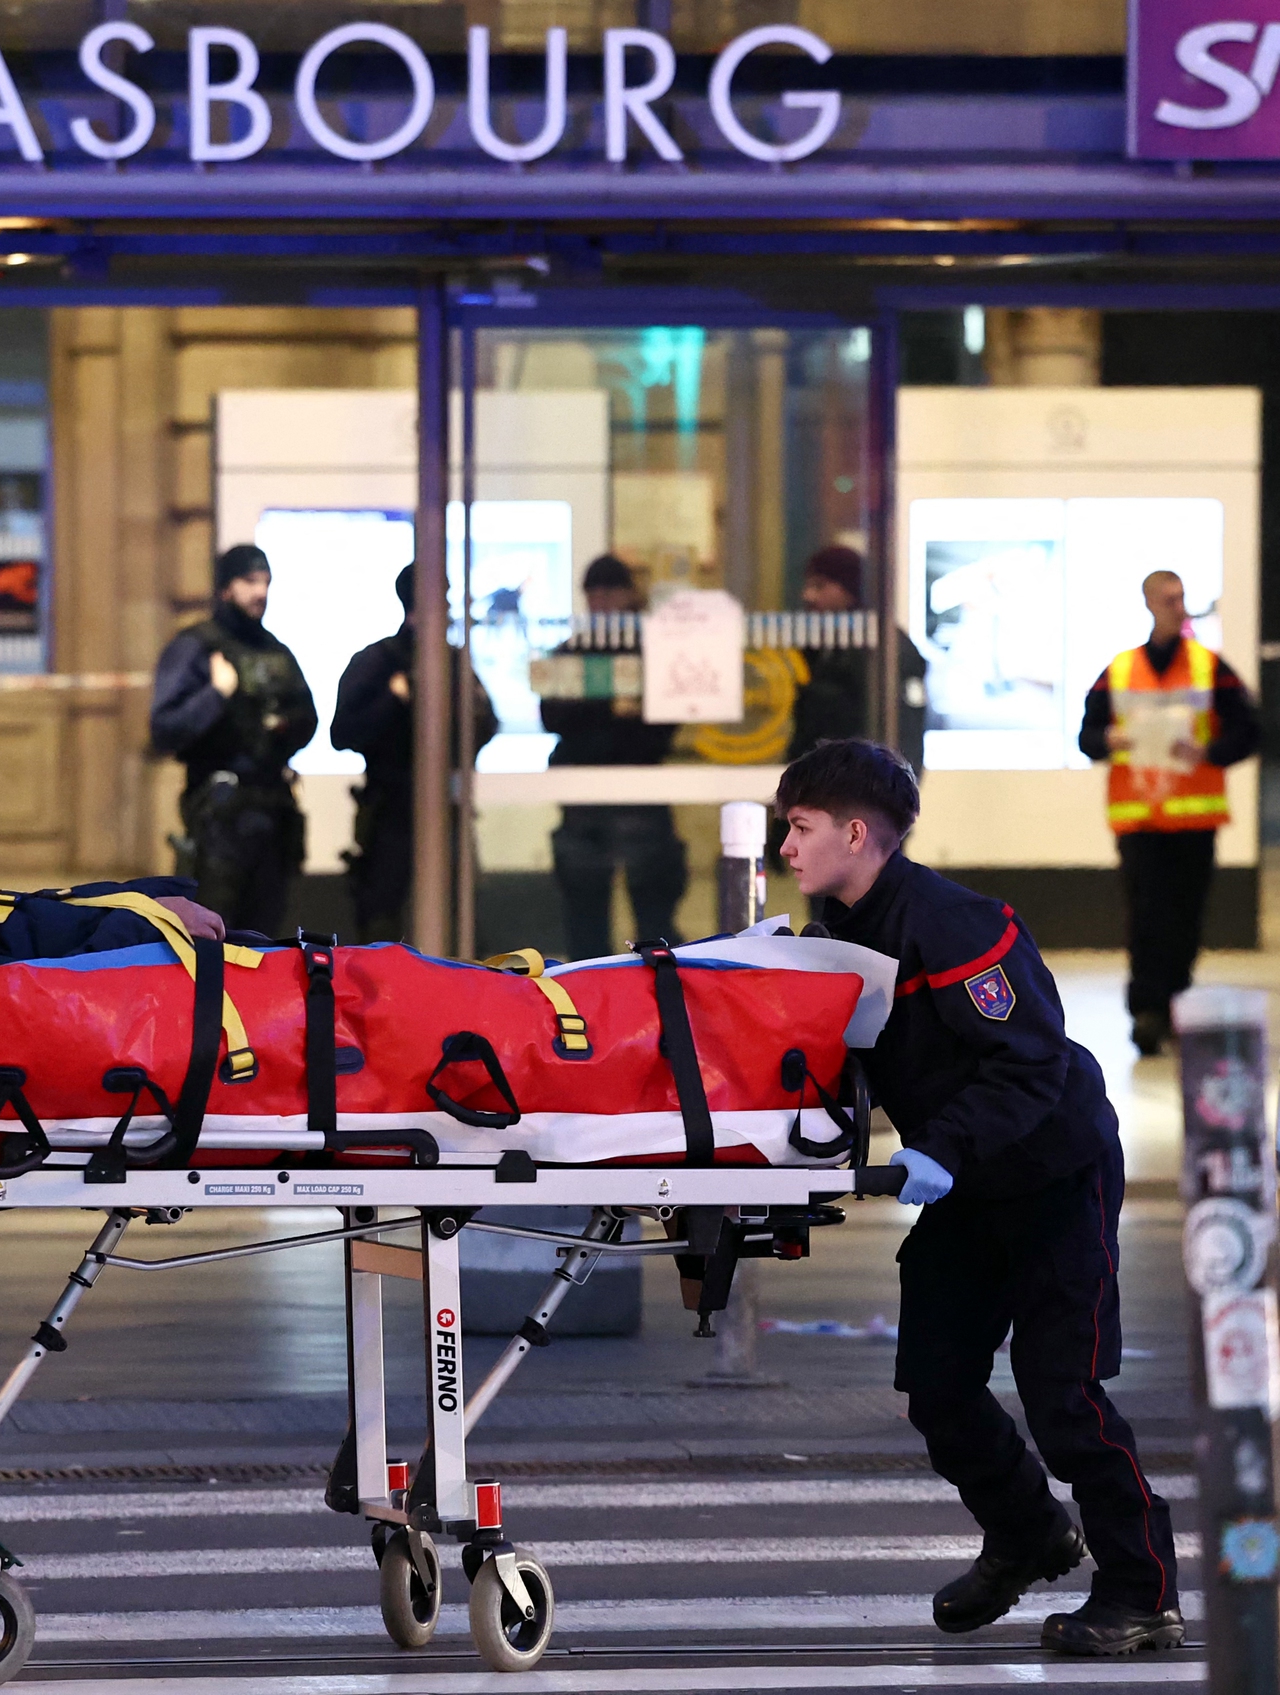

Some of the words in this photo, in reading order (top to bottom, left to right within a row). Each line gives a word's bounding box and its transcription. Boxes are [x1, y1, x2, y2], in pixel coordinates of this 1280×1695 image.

[208, 1185, 234, 1194] CHARGE
[234, 1185, 250, 1193] MAXI
[250, 1185, 262, 1193] 250
[262, 1185, 271, 1194] Kg
[296, 1185, 310, 1193] MAX
[311, 1185, 327, 1193] LOAD
[352, 1186, 361, 1195] Kg
[436, 1330, 458, 1412] FERNO
